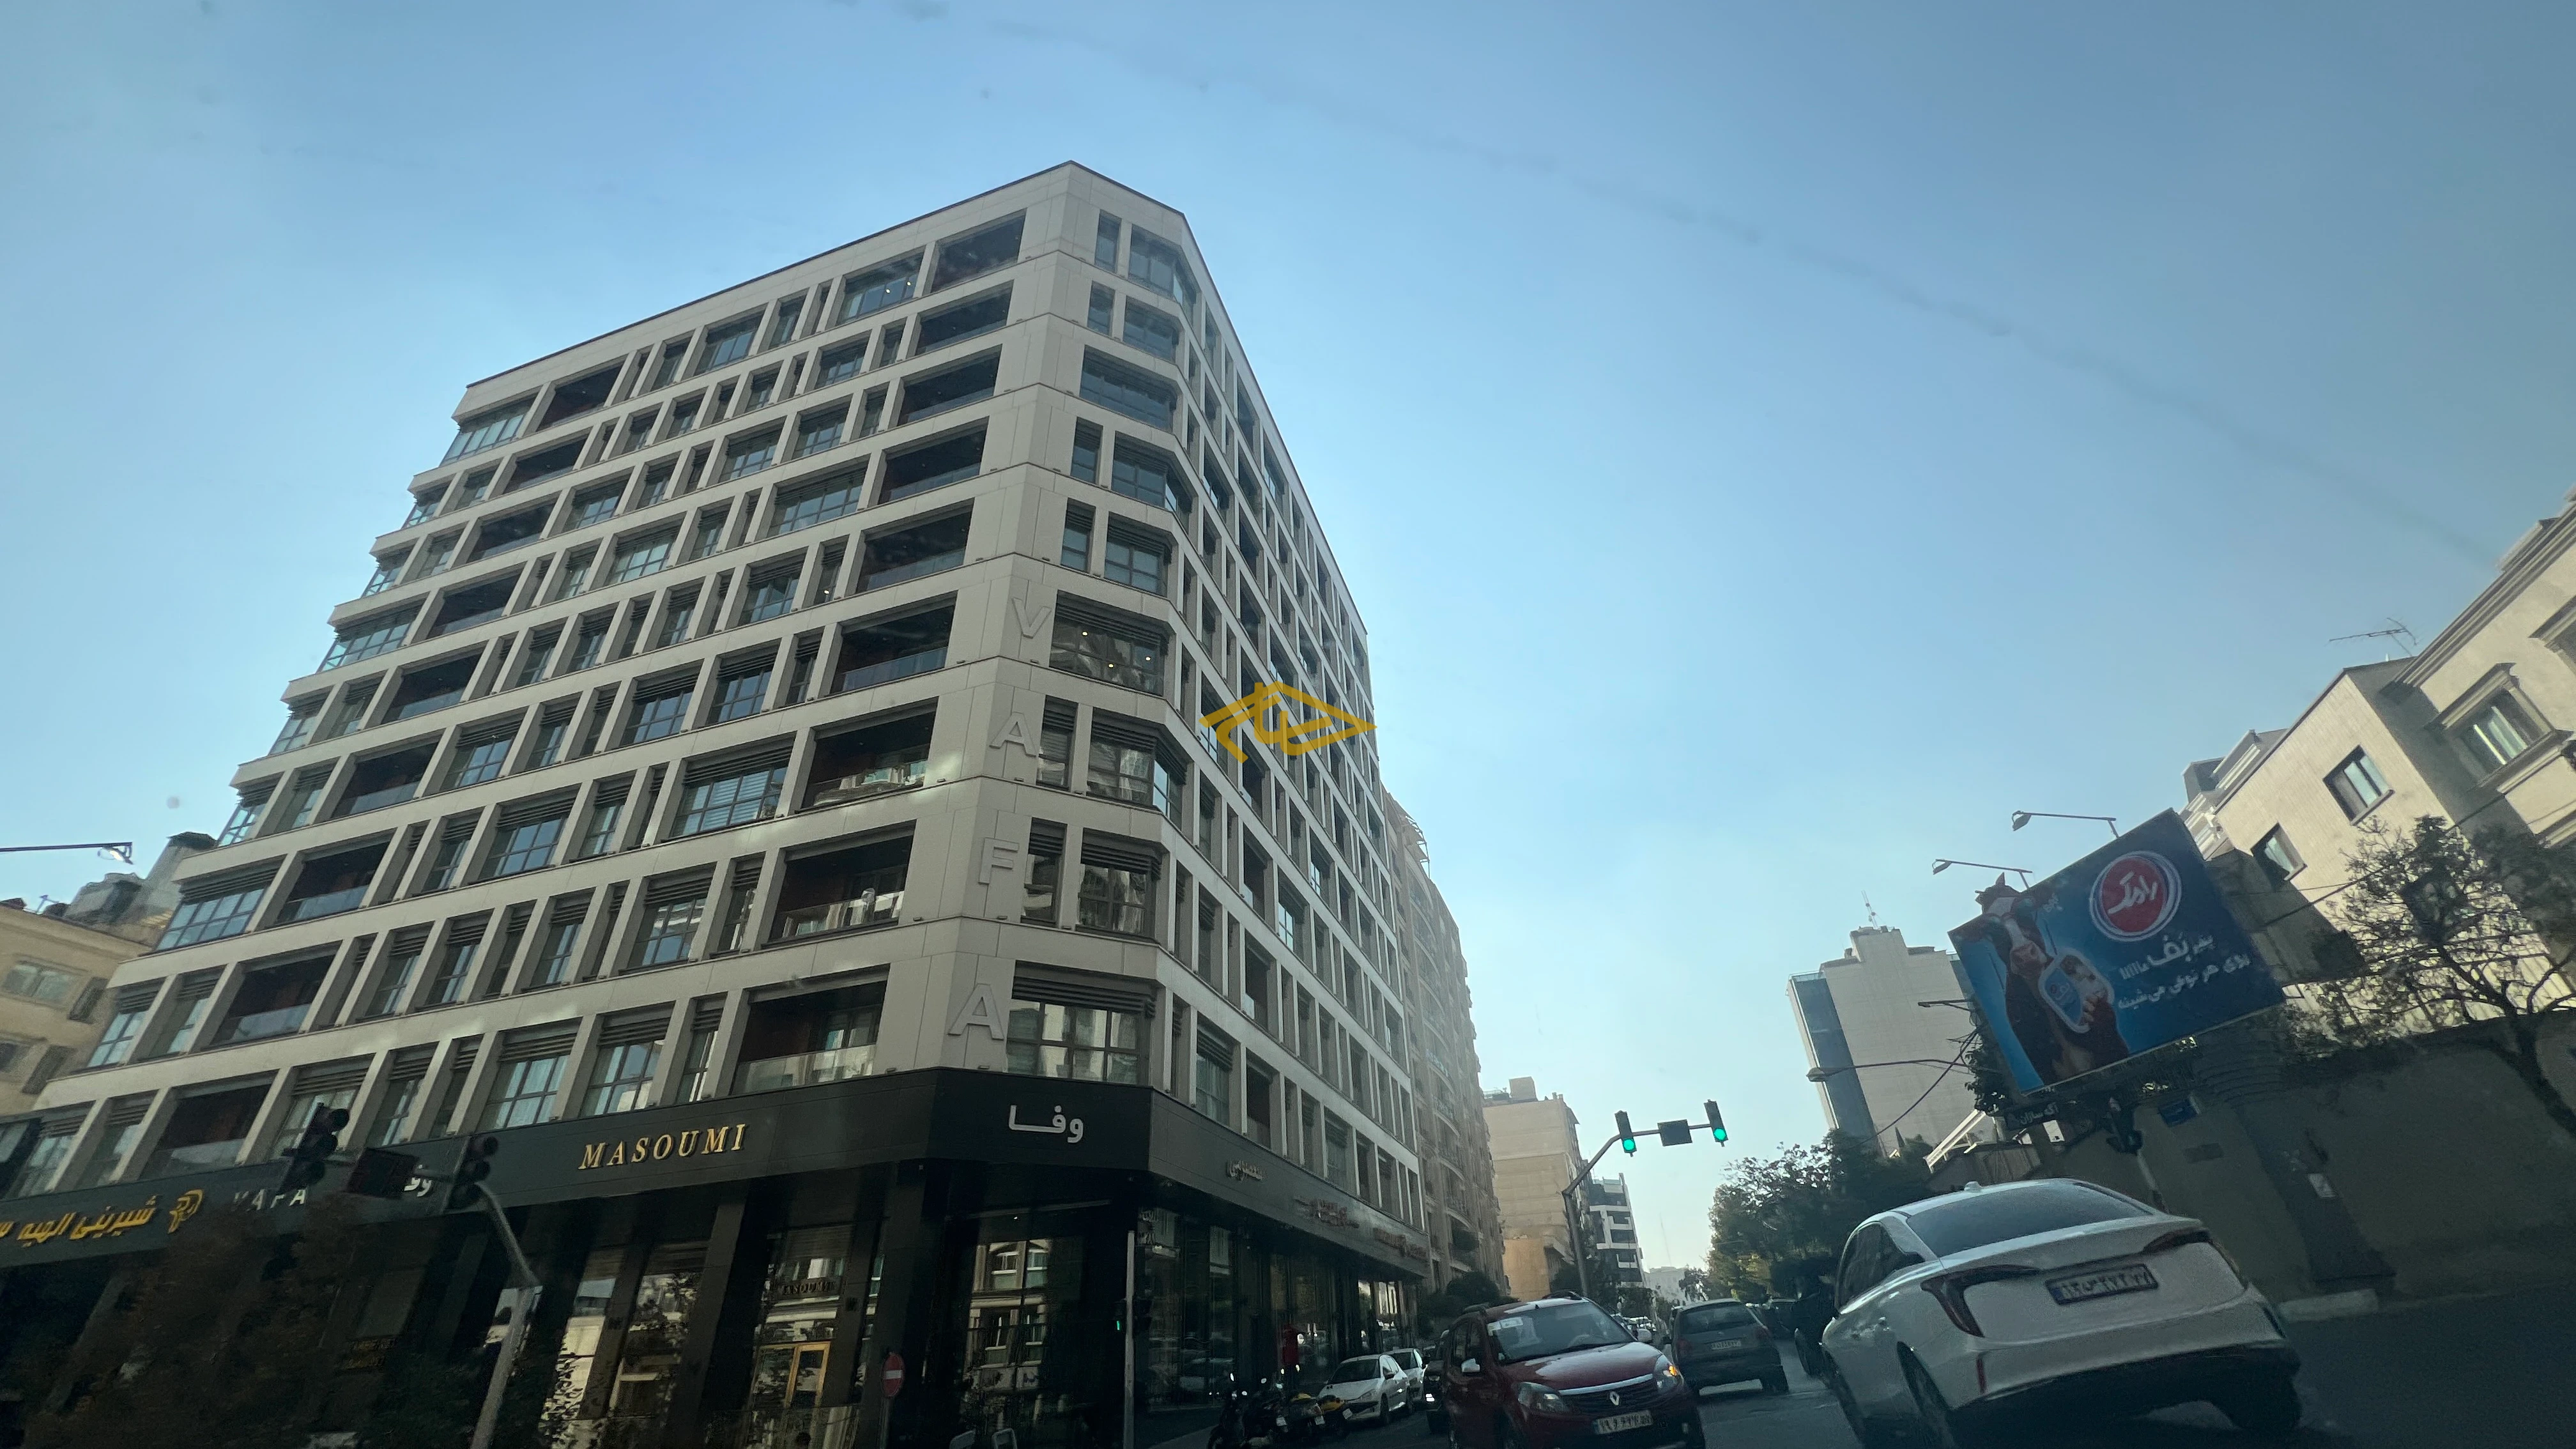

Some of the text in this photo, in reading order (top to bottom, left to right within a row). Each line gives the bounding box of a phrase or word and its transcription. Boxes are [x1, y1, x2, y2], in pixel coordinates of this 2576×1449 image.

[2108, 871, 2158, 914] رامک
[578, 1123, 747, 1170] MASOUMI
[1009, 1105, 1084, 1144] وفا
[69, 1193, 158, 1241] شیرینی
